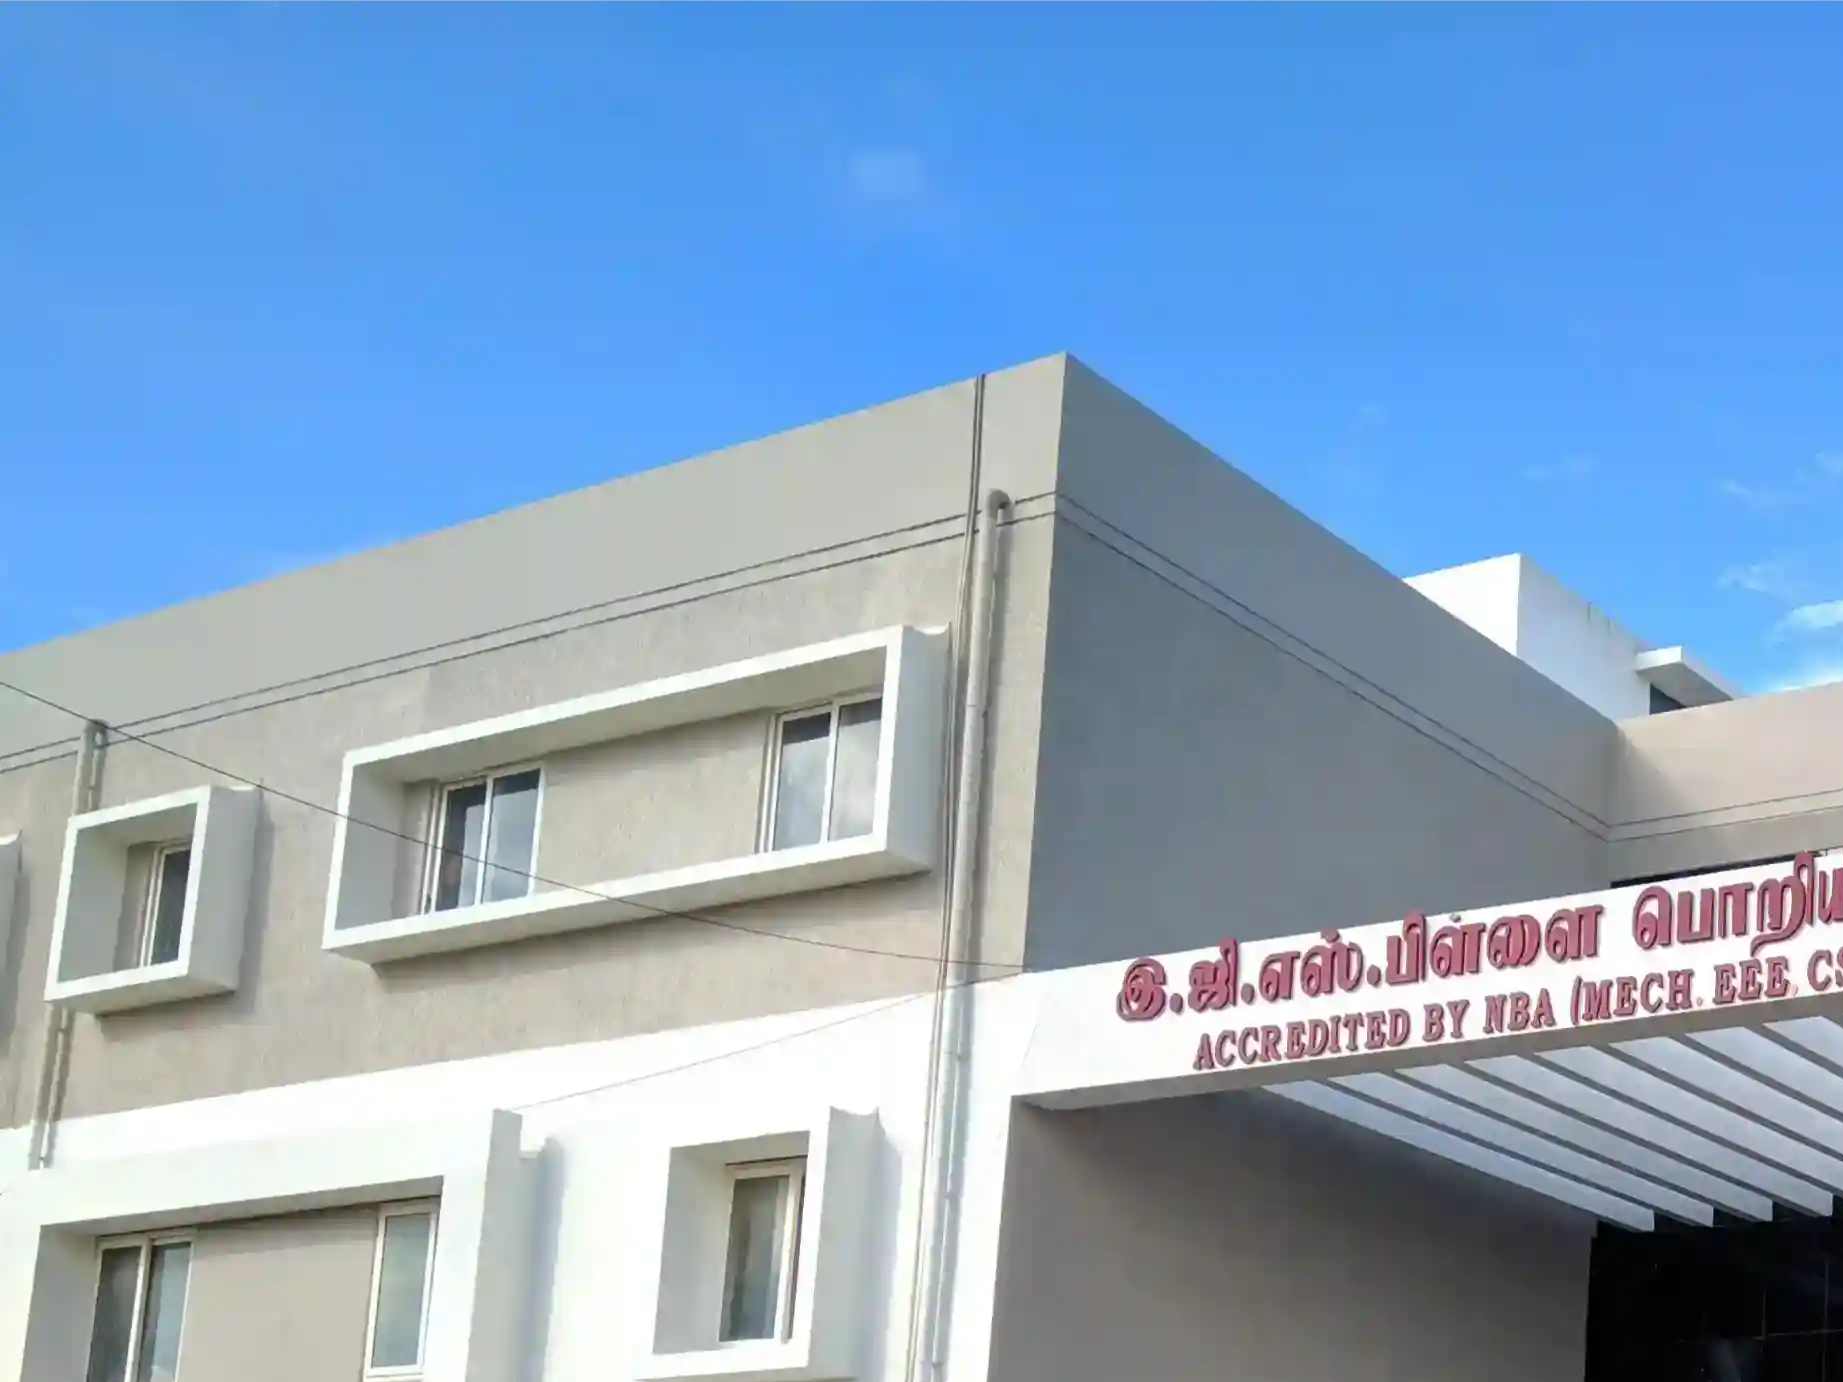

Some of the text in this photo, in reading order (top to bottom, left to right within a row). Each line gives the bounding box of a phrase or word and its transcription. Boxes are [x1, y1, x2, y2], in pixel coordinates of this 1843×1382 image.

[1116, 902, 1604, 1021] இ.ஜி.எஸ்.பிள்ளை
[1193, 1008, 1411, 1070] ACCREDITED
[1422, 999, 1470, 1042] BY
[1482, 987, 1556, 1035] NBA
